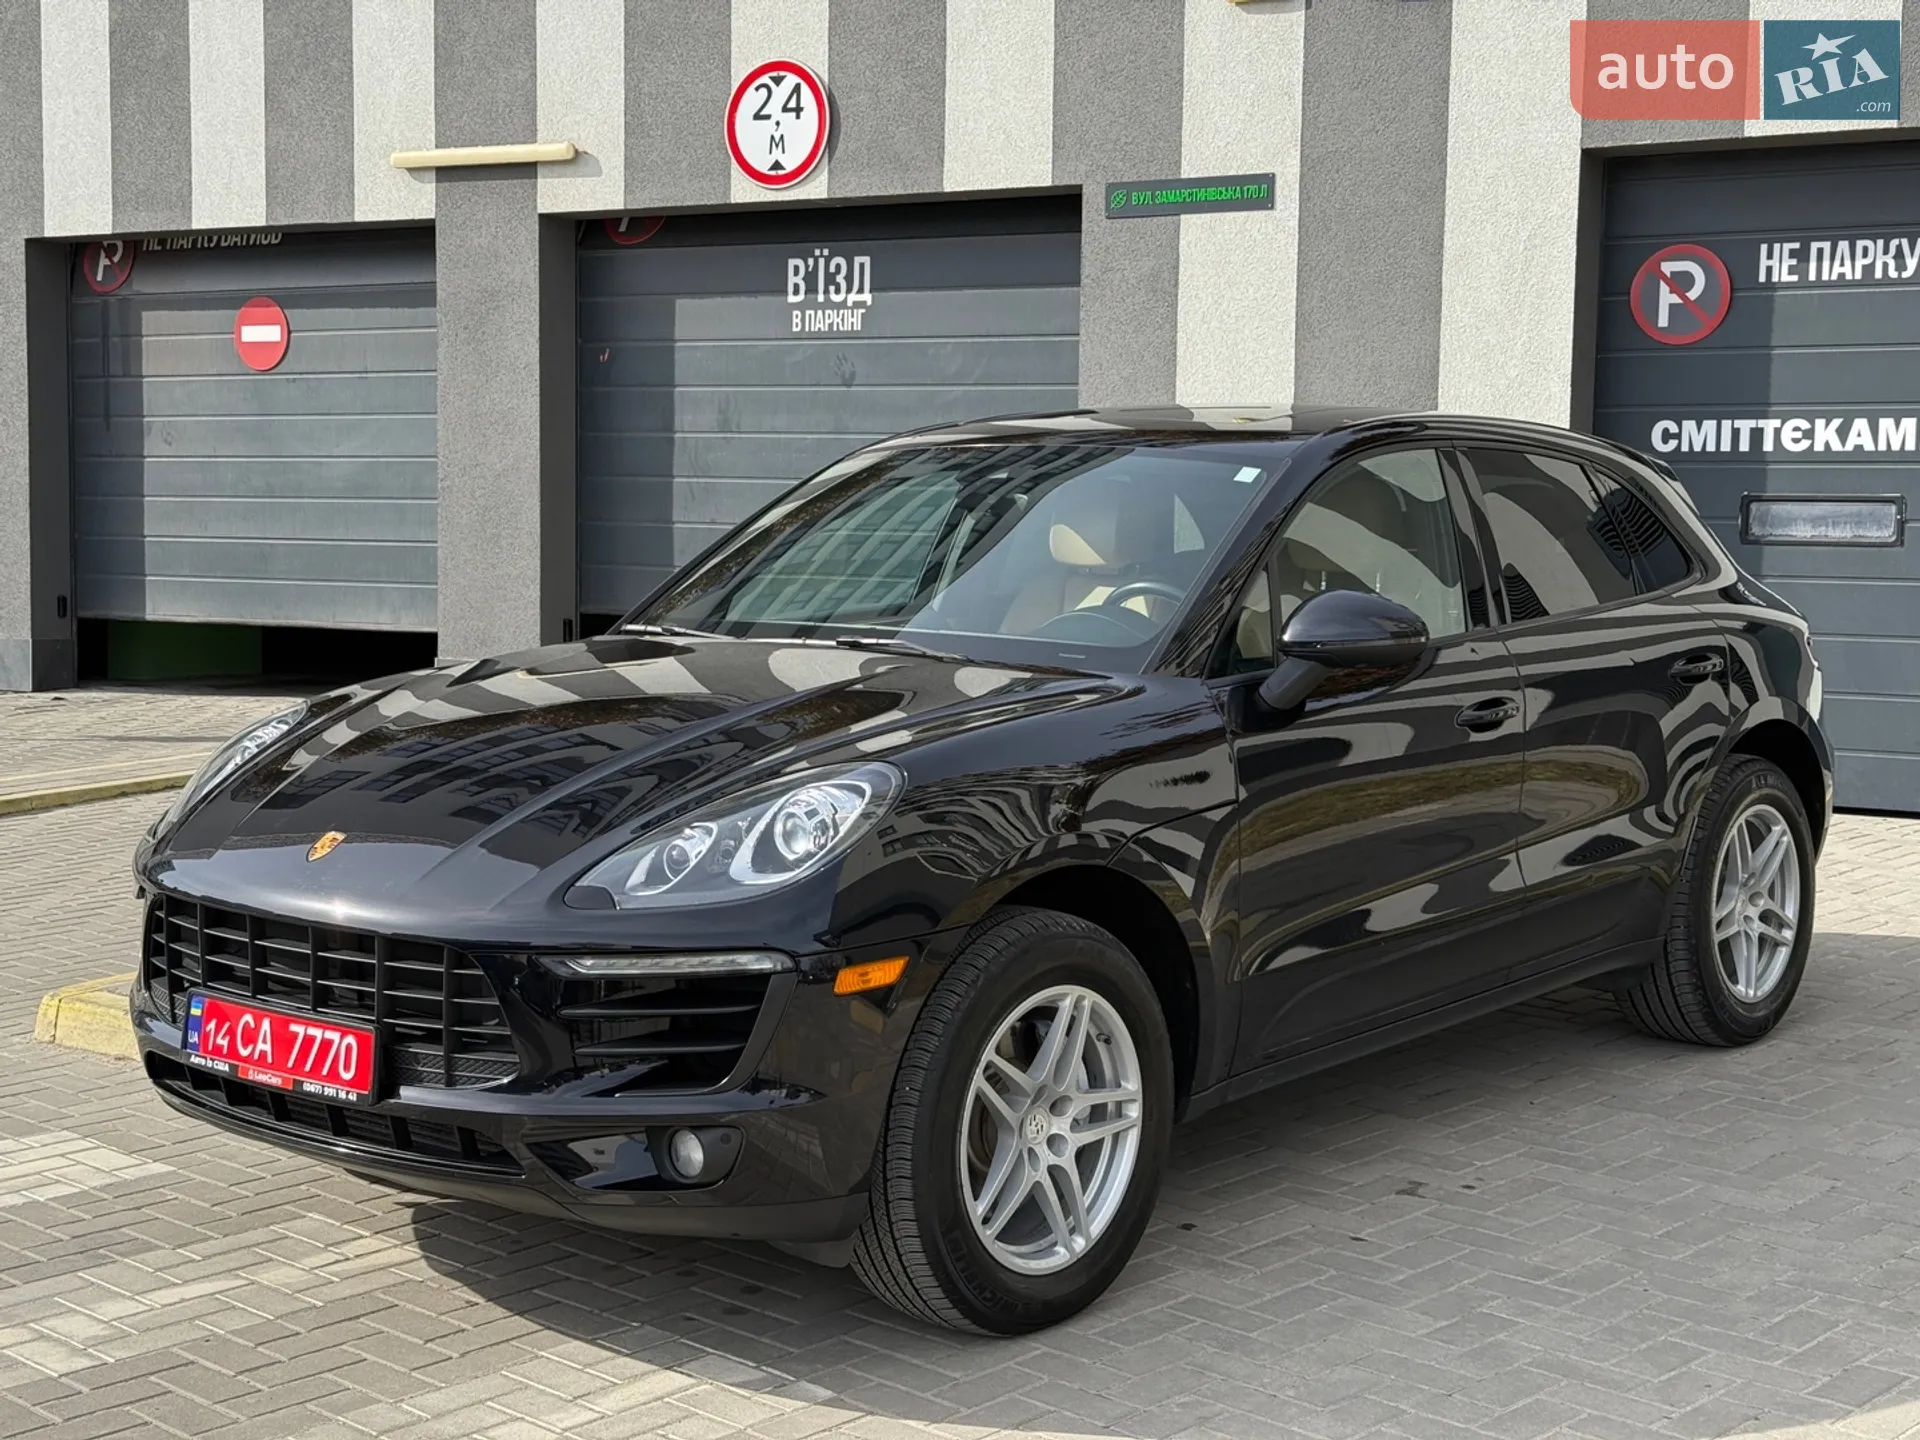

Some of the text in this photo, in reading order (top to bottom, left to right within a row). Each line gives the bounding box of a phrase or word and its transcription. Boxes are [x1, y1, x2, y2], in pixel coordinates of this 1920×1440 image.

[752, 82, 804, 132] 2,4
[1155, 186, 1241, 204] ЗАМАРСТИНІВСЬКА
[1242, 185, 1259, 199] 170
[1260, 184, 1268, 198] Л
[787, 248, 872, 307] В'ЇЗД
[1758, 237, 1920, 283] НЕ ПАРКУ
[792, 308, 866, 332] В ПАРКІНГ
[1651, 417, 1917, 452] СМІТТЄКАМ
[188, 1030, 200, 1044] UA
[205, 1018, 231, 1055] 14
[287, 1023, 359, 1081] 7770
[213, 1060, 230, 1072] США
